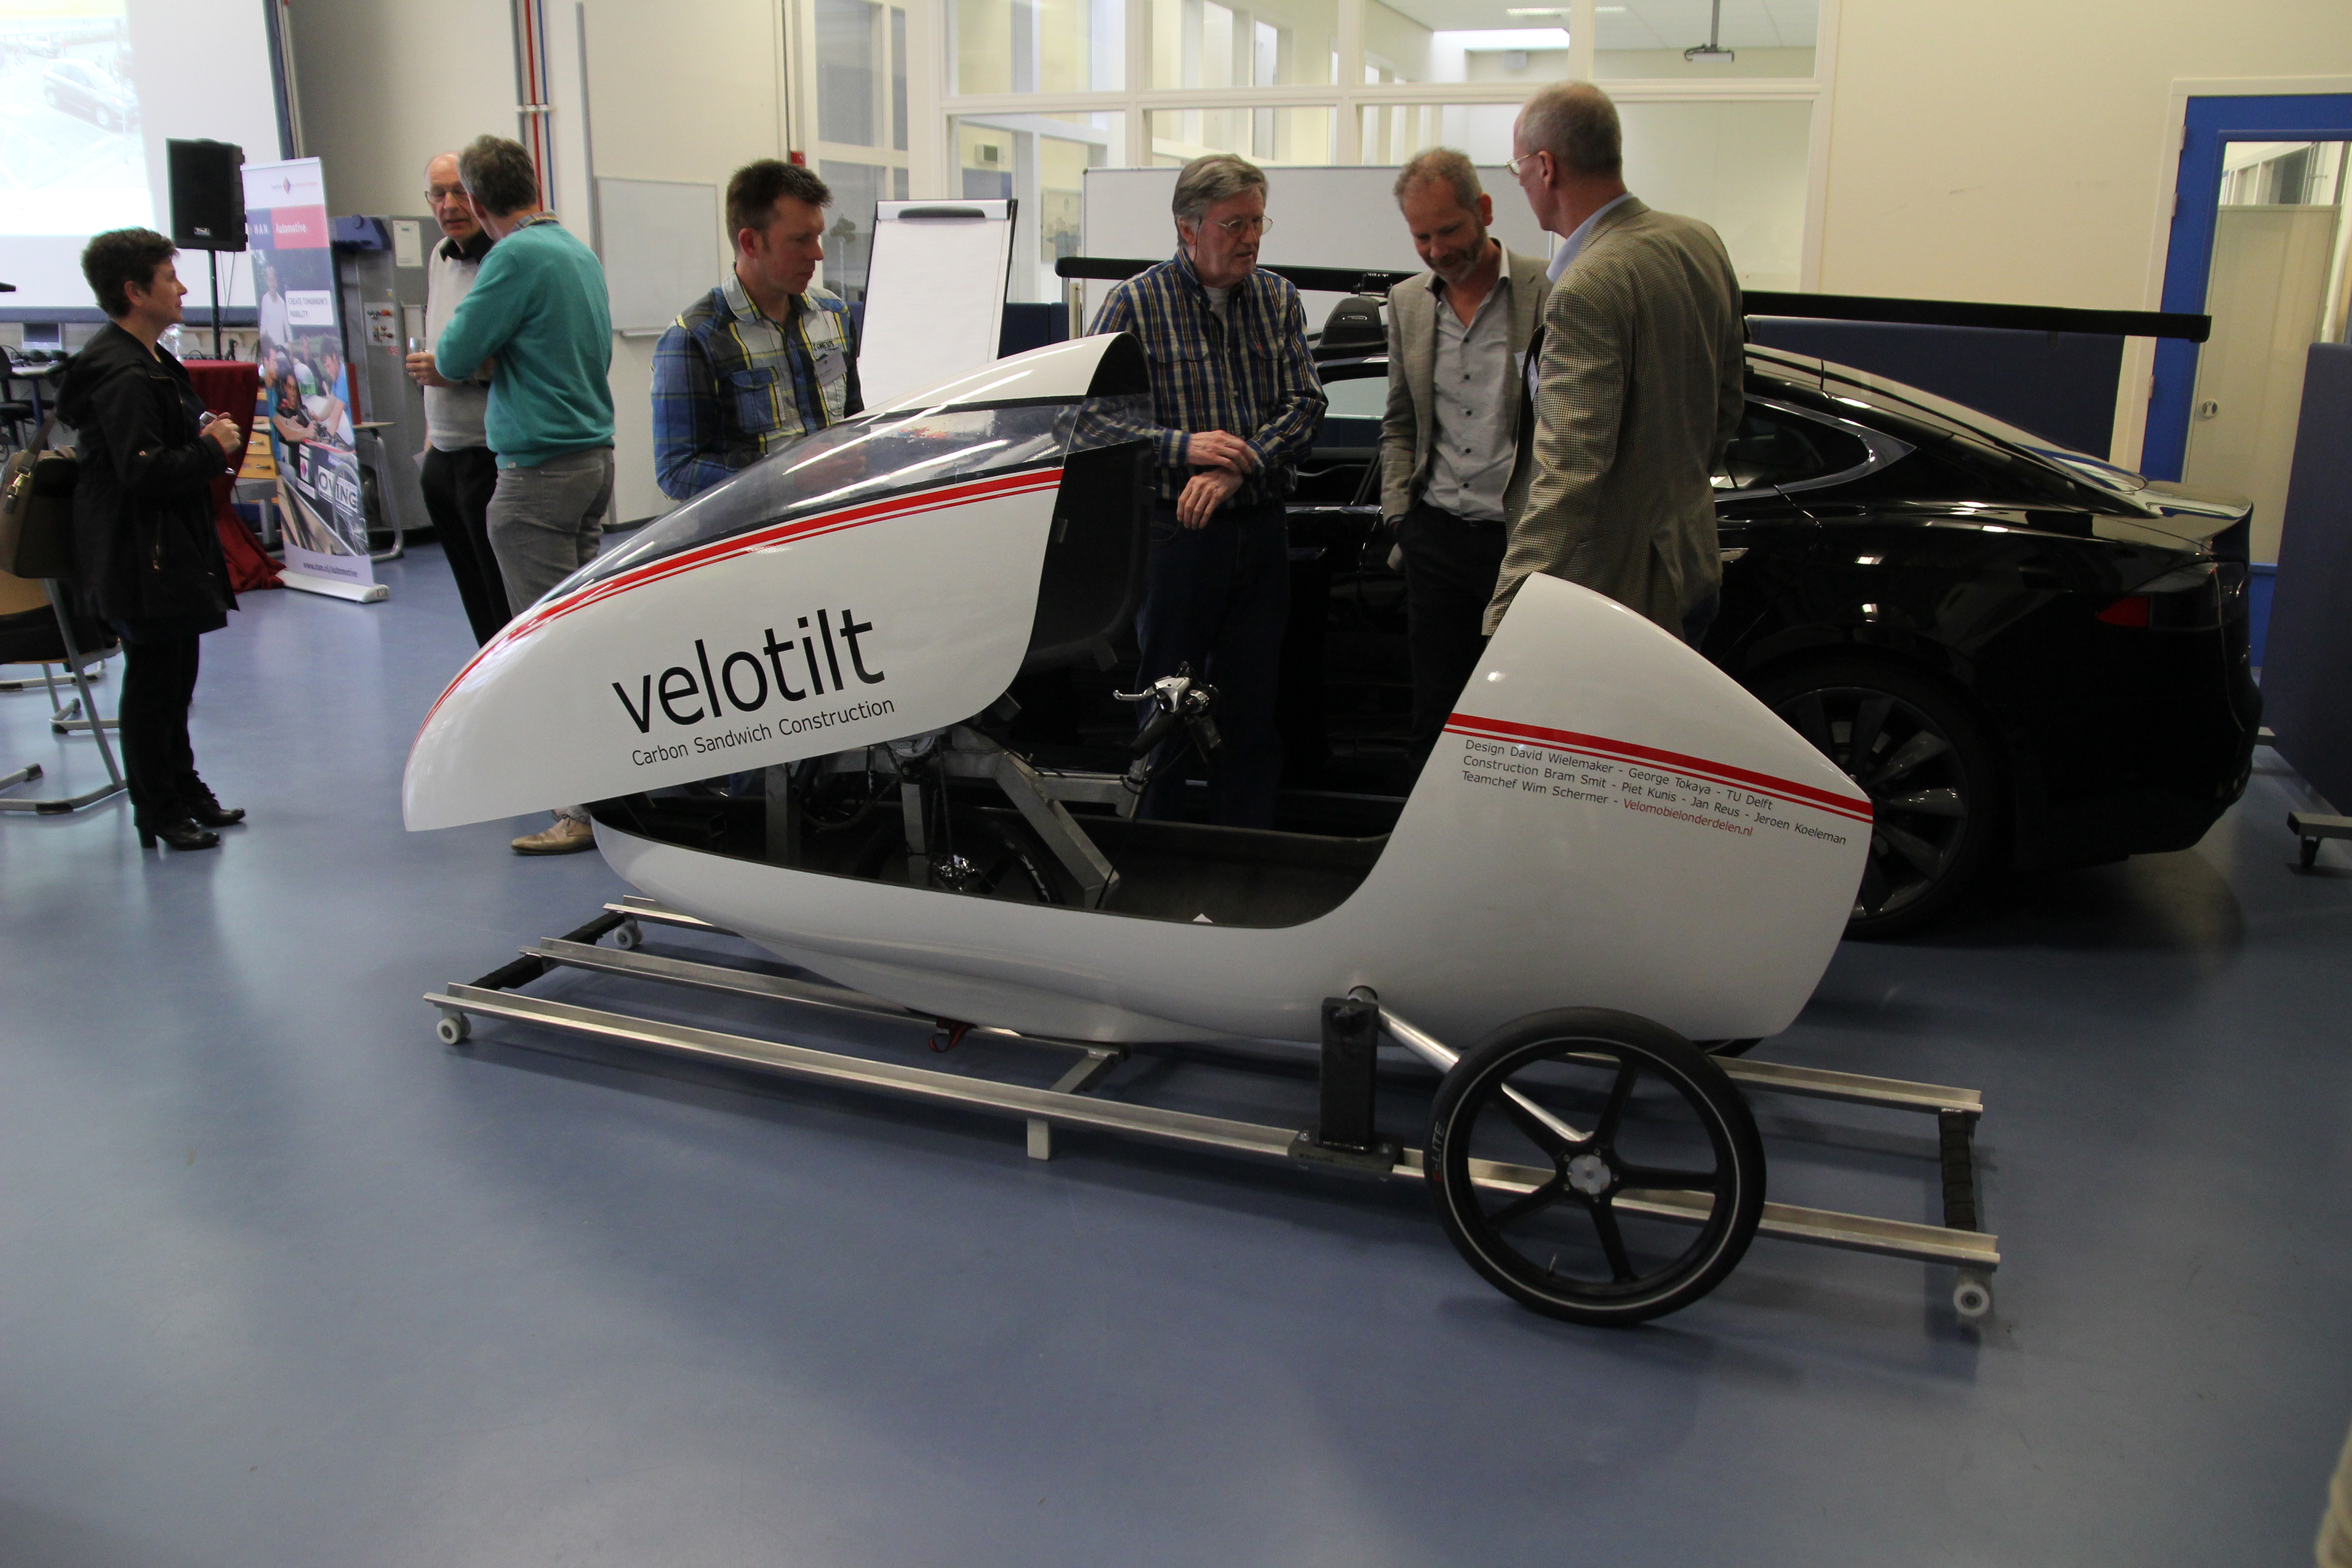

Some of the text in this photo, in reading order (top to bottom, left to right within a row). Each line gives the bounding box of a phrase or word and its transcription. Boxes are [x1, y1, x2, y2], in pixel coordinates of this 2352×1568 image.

[254, 221, 306, 234] HAN Automotive
[612, 608, 885, 733] velotilt
[632, 700, 895, 765] Carbon Sandwich Construction
[1462, 770, 1517, 788] Teamchef
[1522, 781, 1546, 794] Wim
[1552, 786, 1608, 803] Schermer
[1624, 798, 1753, 836] Velomobielonderdelen.nl
[1464, 755, 1539, 775] Construction
[1544, 768, 1574, 782] Bram
[1580, 774, 1607, 788] Smit
[1622, 782, 1642, 795] Piet
[1647, 787, 1676, 801] Kunis
[1690, 797, 1709, 809] Jan
[1714, 802, 1740, 817] Reus
[1754, 813, 1789, 829] Jeroen
[1794, 823, 1846, 845] Koeleman
[1465, 740, 1504, 755] Design
[1510, 746, 1542, 760] David
[1548, 753, 1614, 773] Wielemaker
[1629, 768, 1669, 785] George
[1675, 777, 1710, 795] Tokaya
[1727, 789, 1741, 801] TU
[1746, 795, 1773, 810] Delft
